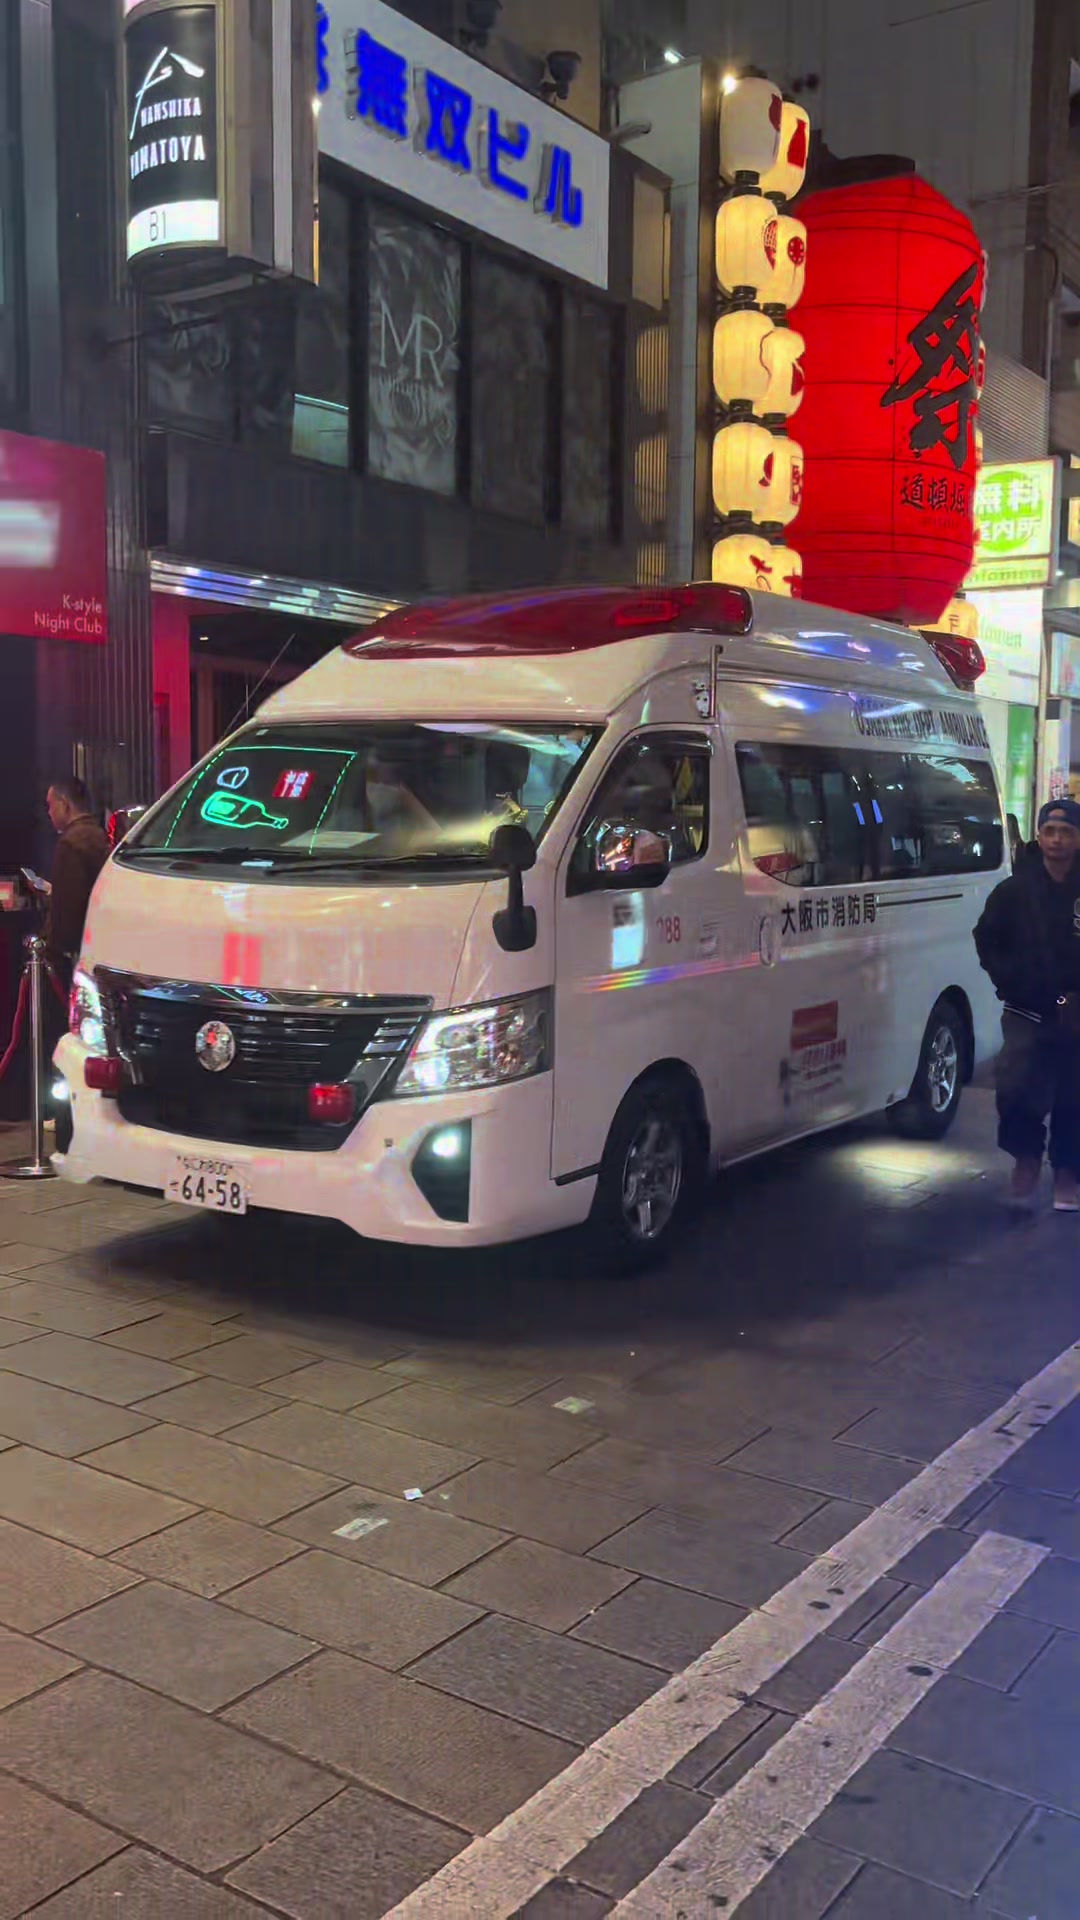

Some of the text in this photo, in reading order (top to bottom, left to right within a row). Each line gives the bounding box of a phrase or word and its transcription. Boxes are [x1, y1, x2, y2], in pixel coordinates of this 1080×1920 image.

[149, 211, 167, 242] B1
[901, 473, 966, 517] 道頓堀
[62, 593, 102, 616] K-style
[33, 611, 102, 634] Night Club
[781, 893, 876, 935] 大阪市消防局
[182, 1175, 240, 1208] 64-58
